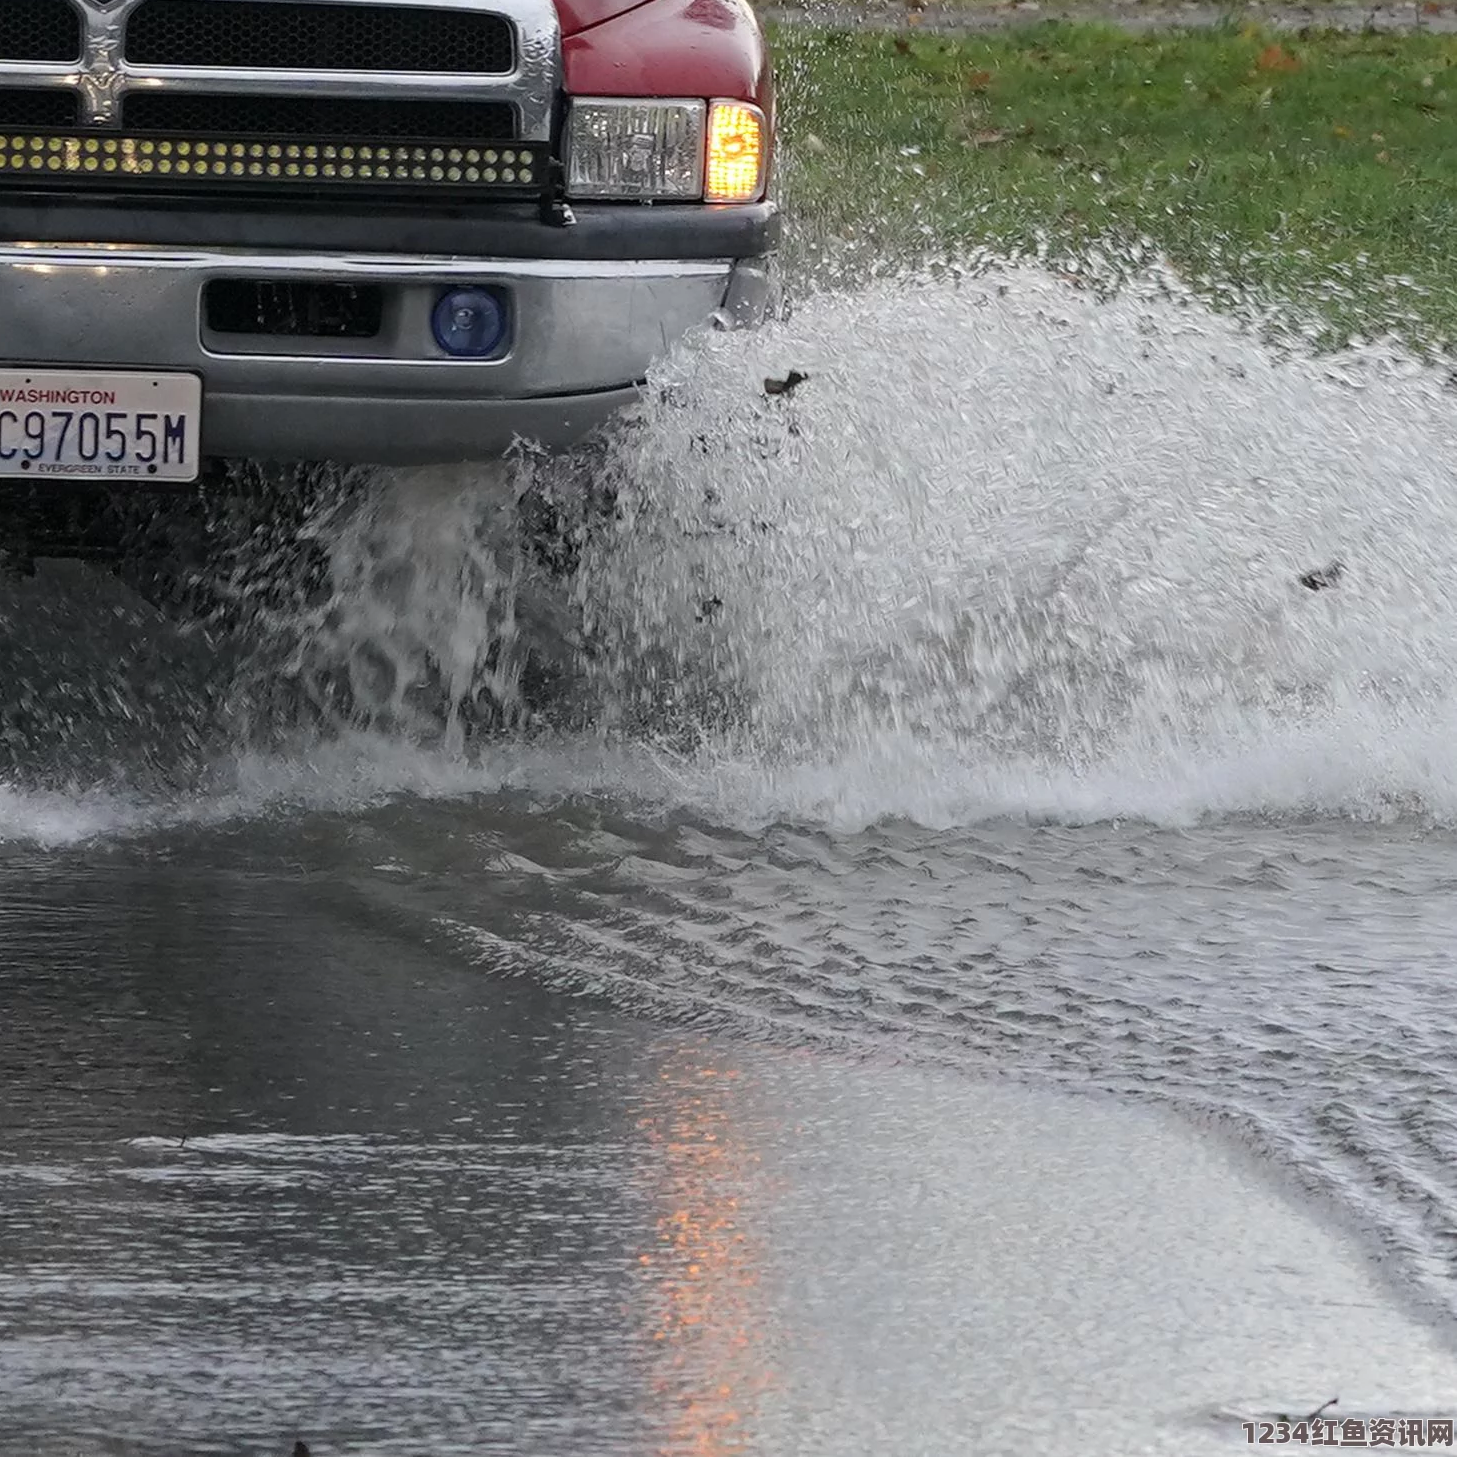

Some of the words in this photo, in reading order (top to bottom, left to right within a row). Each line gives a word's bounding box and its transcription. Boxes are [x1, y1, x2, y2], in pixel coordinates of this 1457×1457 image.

[0, 389, 116, 405] WASHINGTON
[38, 463, 102, 474] EVERGREEN
[107, 465, 141, 475] STATE
